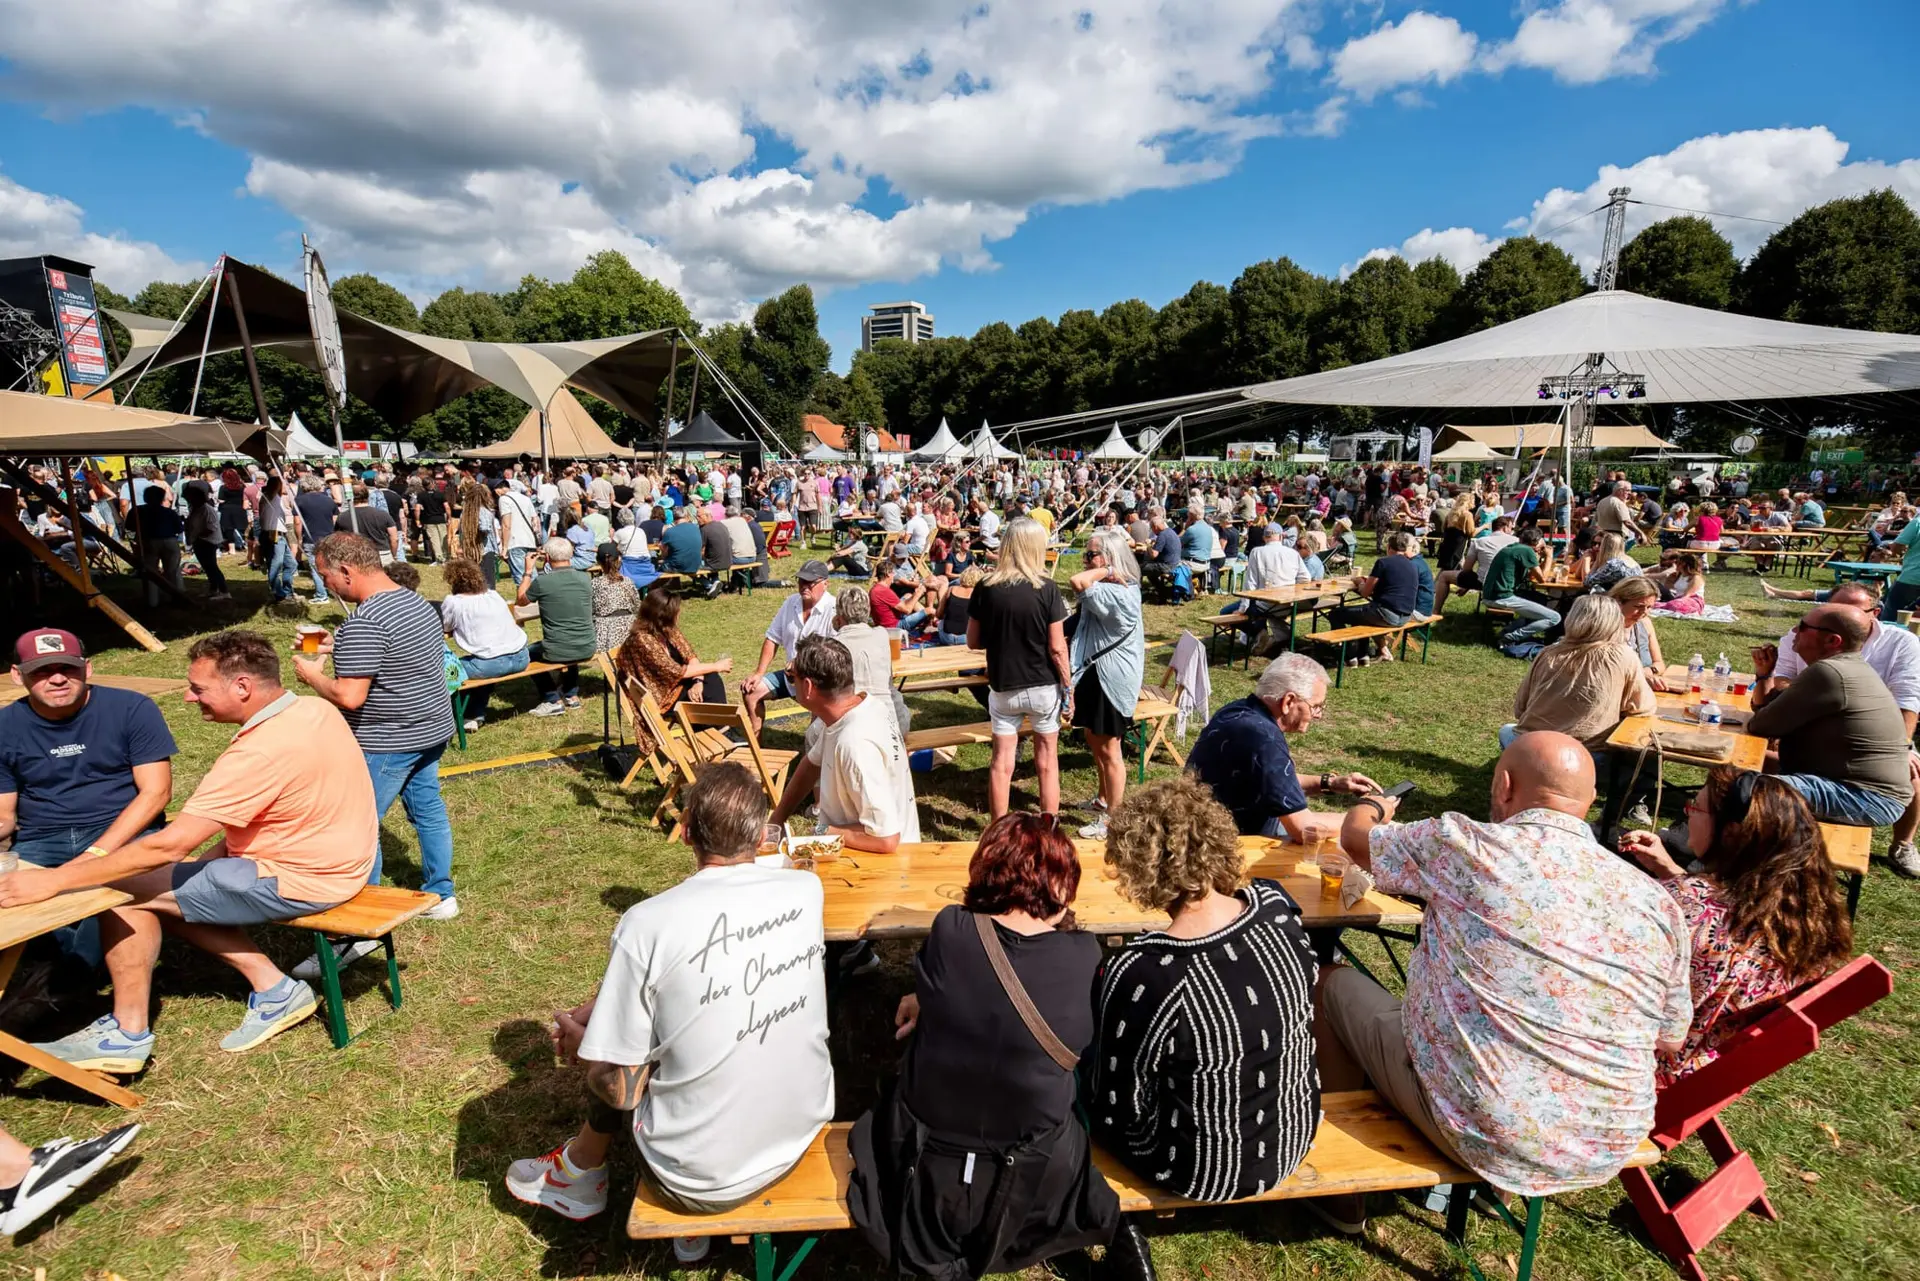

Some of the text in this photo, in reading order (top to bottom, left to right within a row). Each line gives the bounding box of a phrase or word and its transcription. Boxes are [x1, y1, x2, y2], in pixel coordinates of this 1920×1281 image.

[63, 291, 85, 301] Tribute
[324, 345, 339, 370] BAR
[1826, 452, 1846, 460] EXIT
[688, 907, 803, 973] Avenue
[699, 977, 732, 1005] des
[736, 995, 807, 1045] elysees
